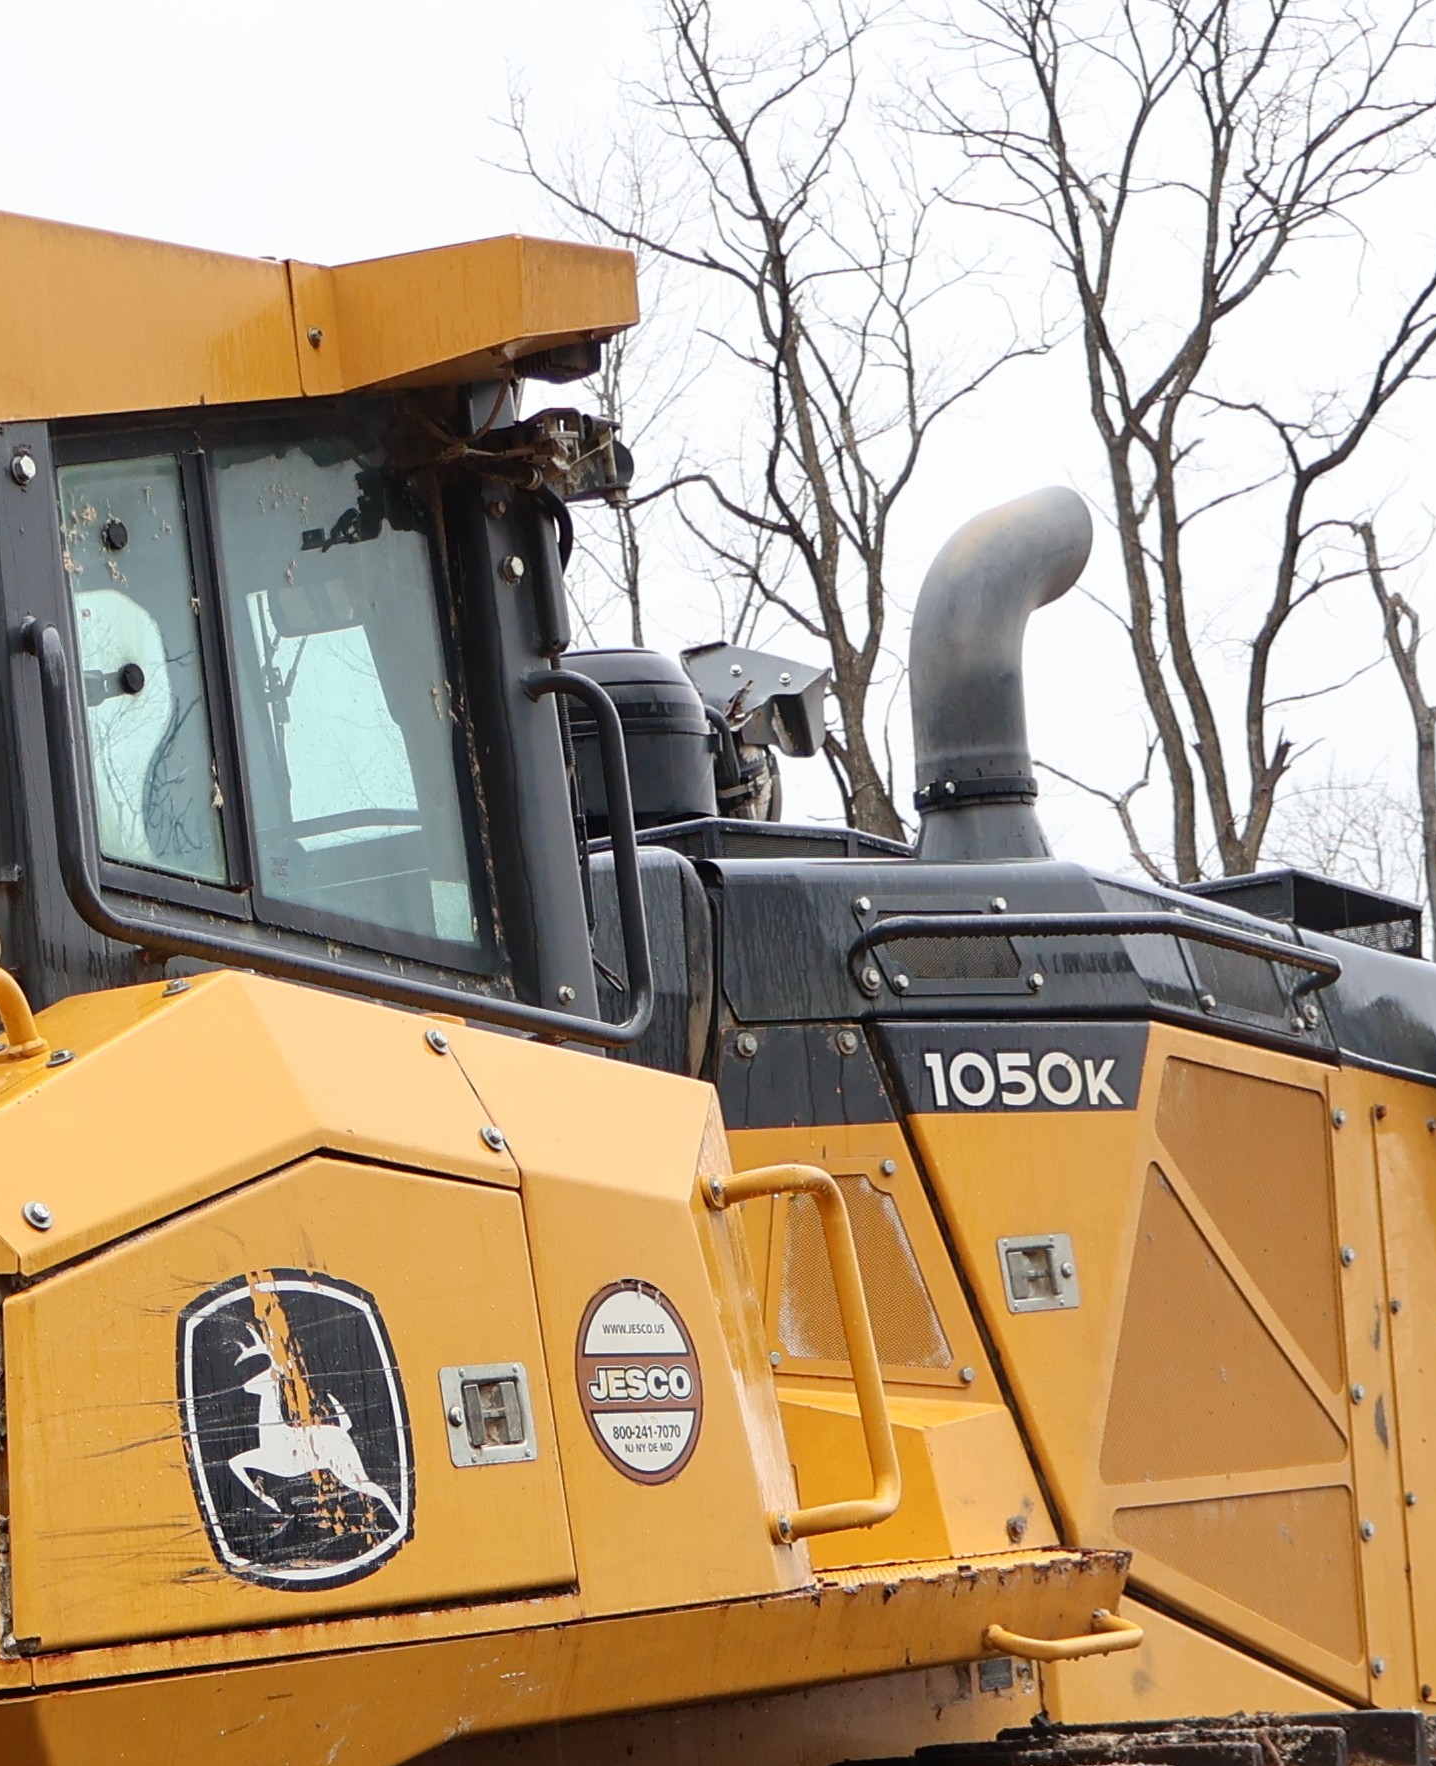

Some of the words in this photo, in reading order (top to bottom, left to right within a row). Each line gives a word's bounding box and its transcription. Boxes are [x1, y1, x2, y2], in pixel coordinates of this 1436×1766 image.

[924, 1051, 1124, 1107] 1050K
[601, 1323, 666, 1335] WWW.JESCO.US
[588, 1365, 693, 1401] JESCO
[612, 1424, 682, 1440] 800-241-7070
